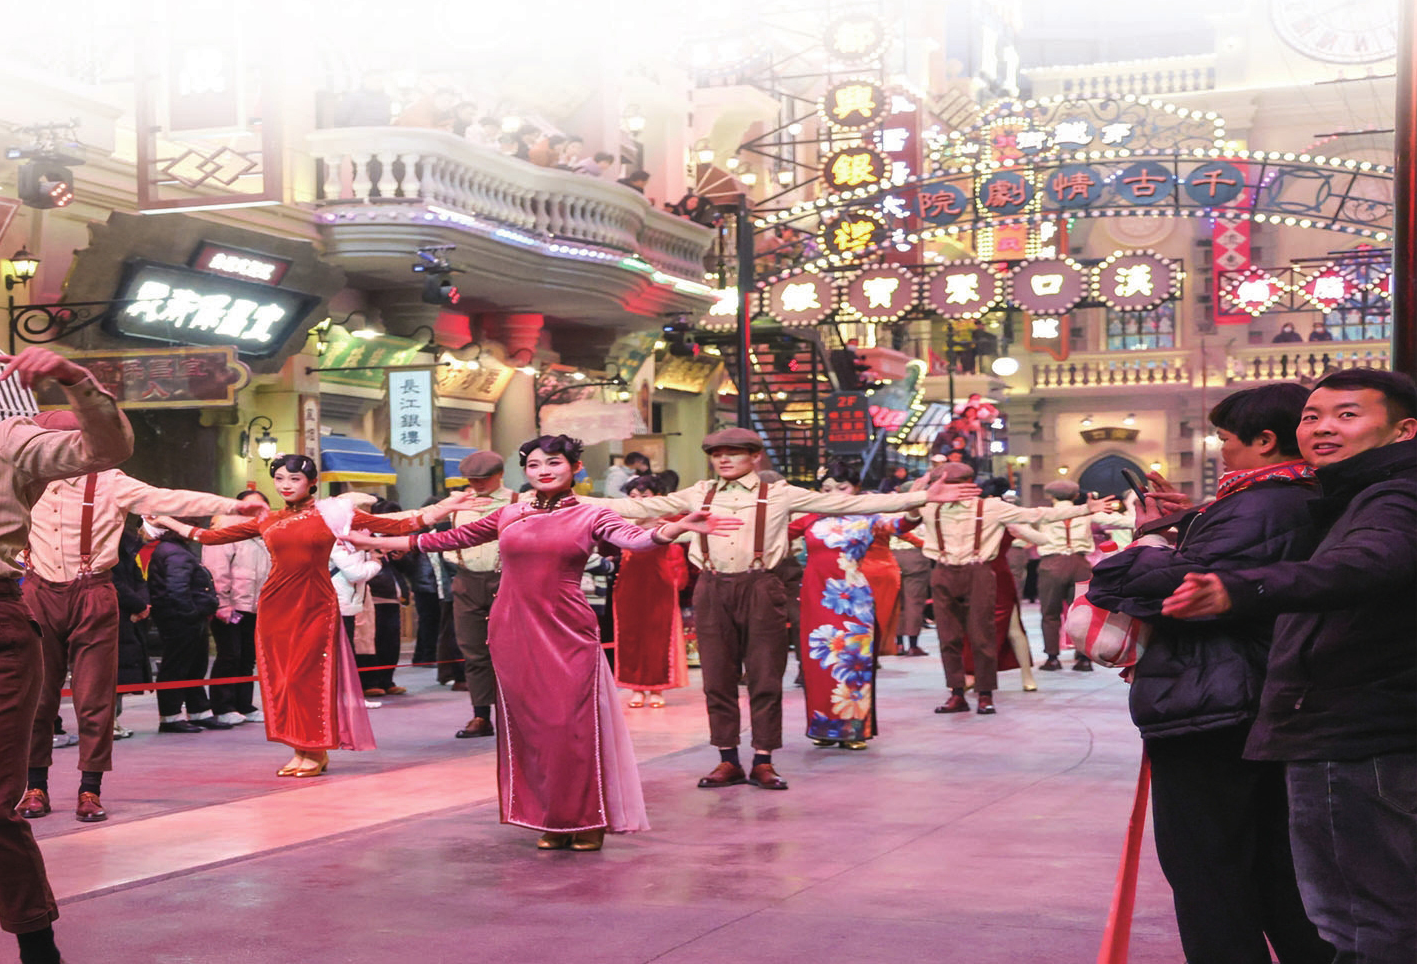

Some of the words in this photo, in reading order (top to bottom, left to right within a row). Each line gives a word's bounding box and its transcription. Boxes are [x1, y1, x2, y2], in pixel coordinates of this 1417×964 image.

[917, 169, 1237, 218] 千古情劇院
[399, 379, 422, 446] 長江銀樓
